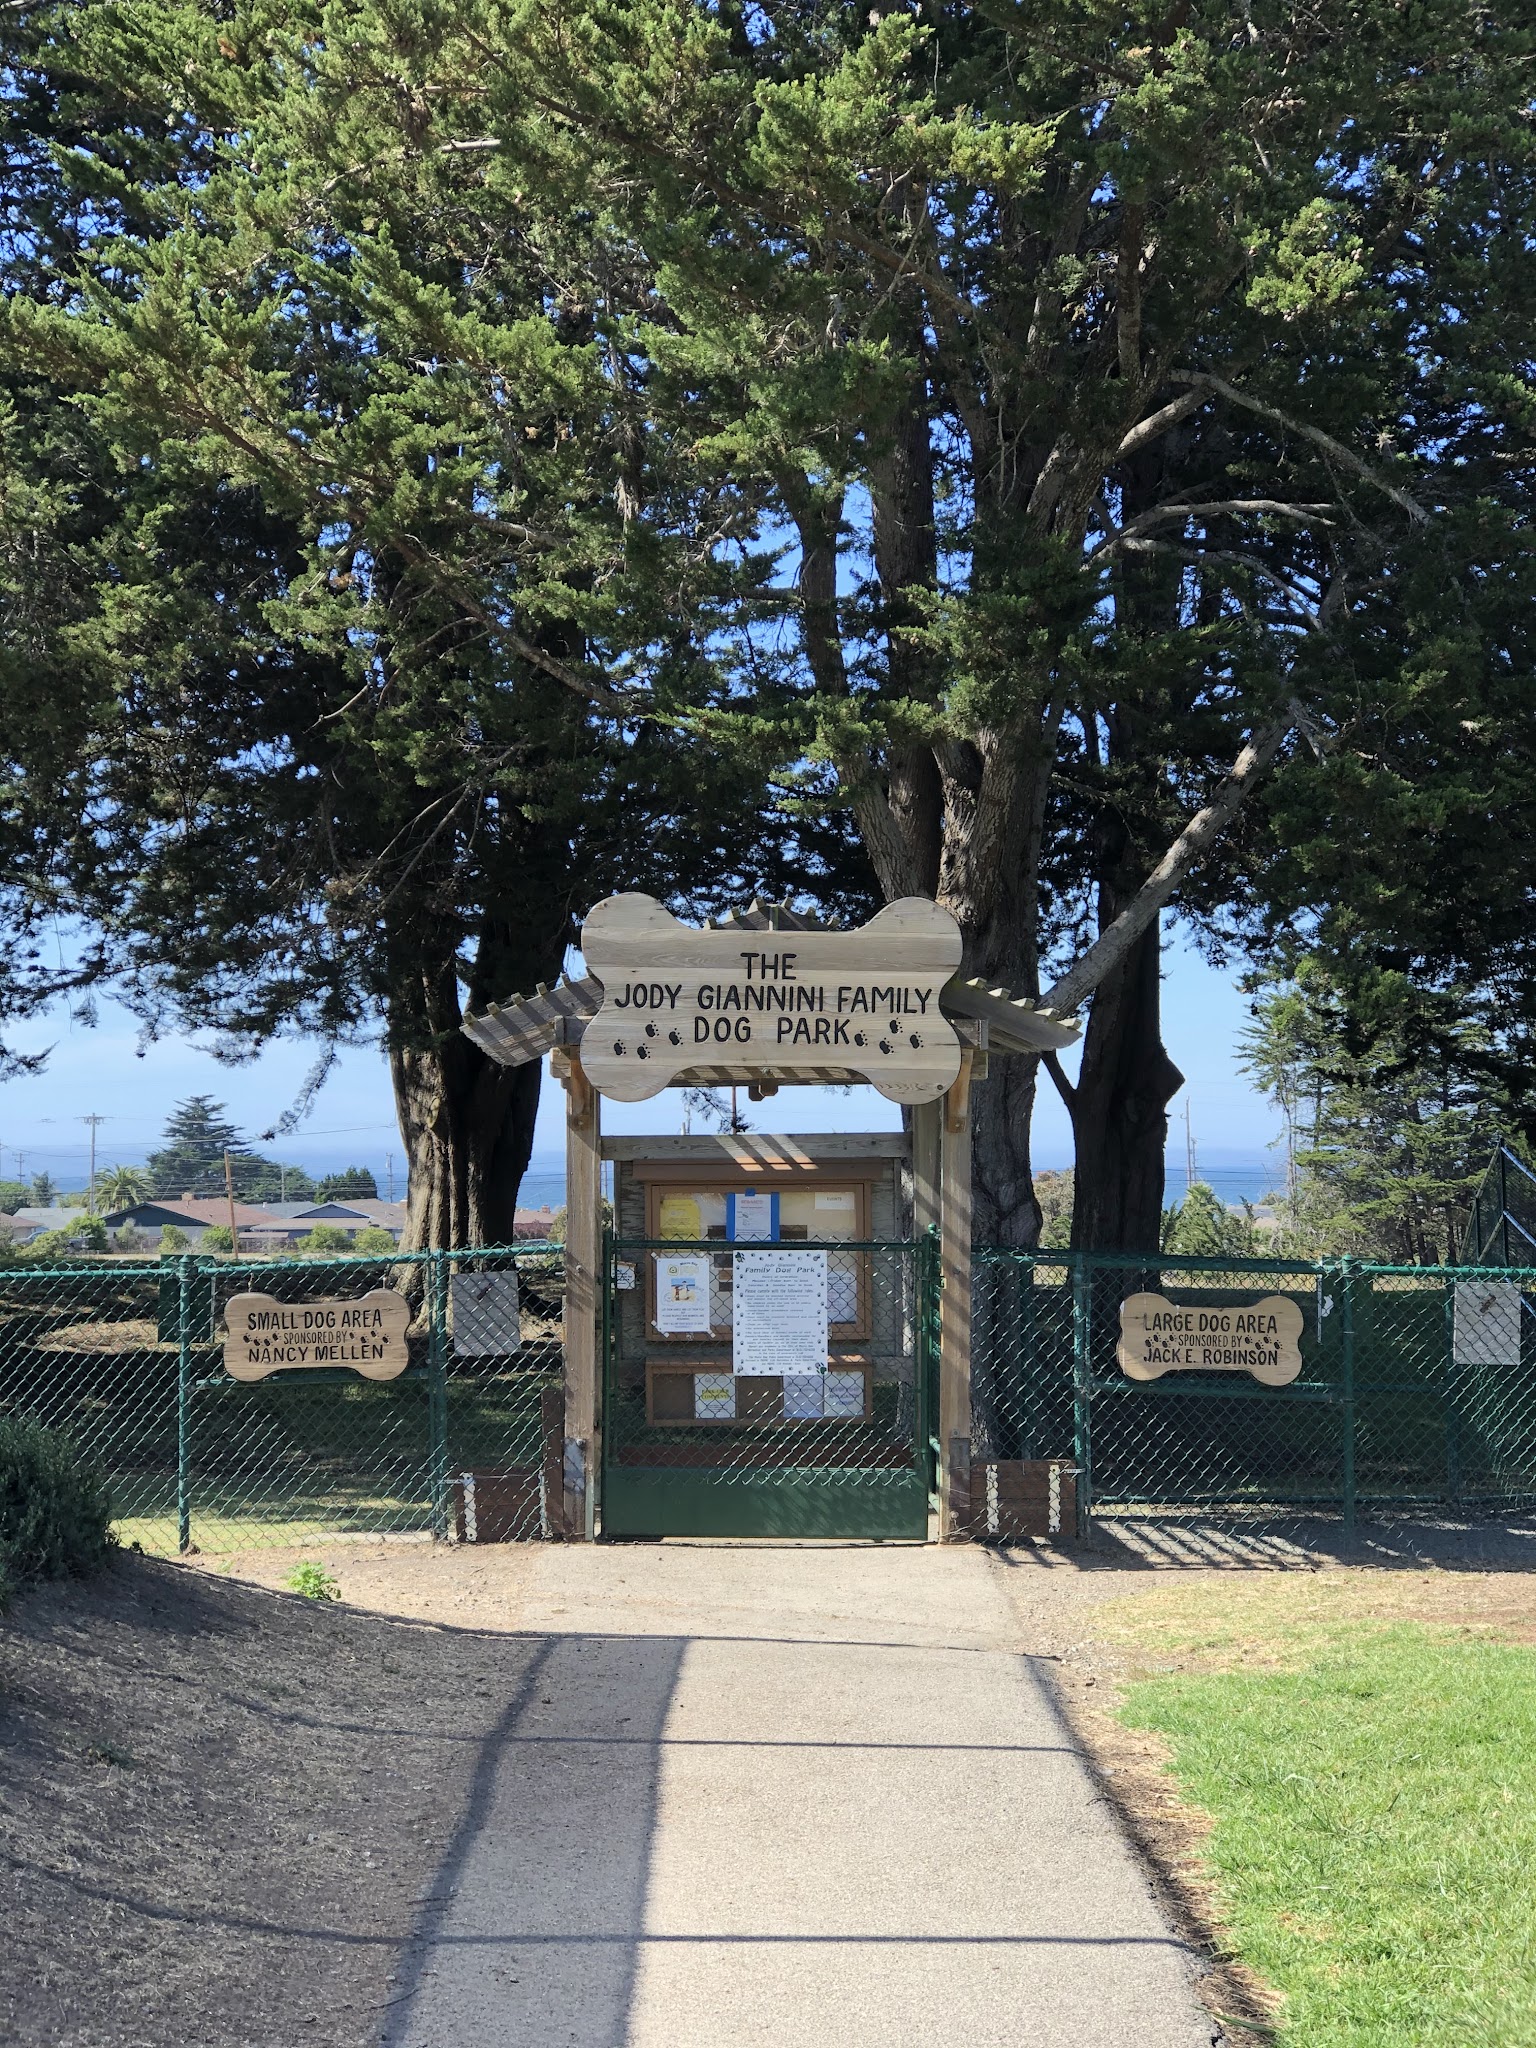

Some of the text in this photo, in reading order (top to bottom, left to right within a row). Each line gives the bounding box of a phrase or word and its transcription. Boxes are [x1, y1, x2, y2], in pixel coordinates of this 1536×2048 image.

[740, 952, 797, 980] THE
[614, 983, 933, 1015] JODY GIANNINI FAMILY
[694, 1016, 852, 1045] DOG PARK
[247, 1308, 383, 1331] SMALL DOG AREA
[1143, 1312, 1278, 1334] LARGE DOG AREA
[283, 1330, 348, 1346] SPONSORED BY
[1177, 1333, 1243, 1348] SPONSORED BY
[248, 1345, 383, 1363] NANCY MELLEN
[1143, 1346, 1279, 1366] JACK E. ROBINSON
